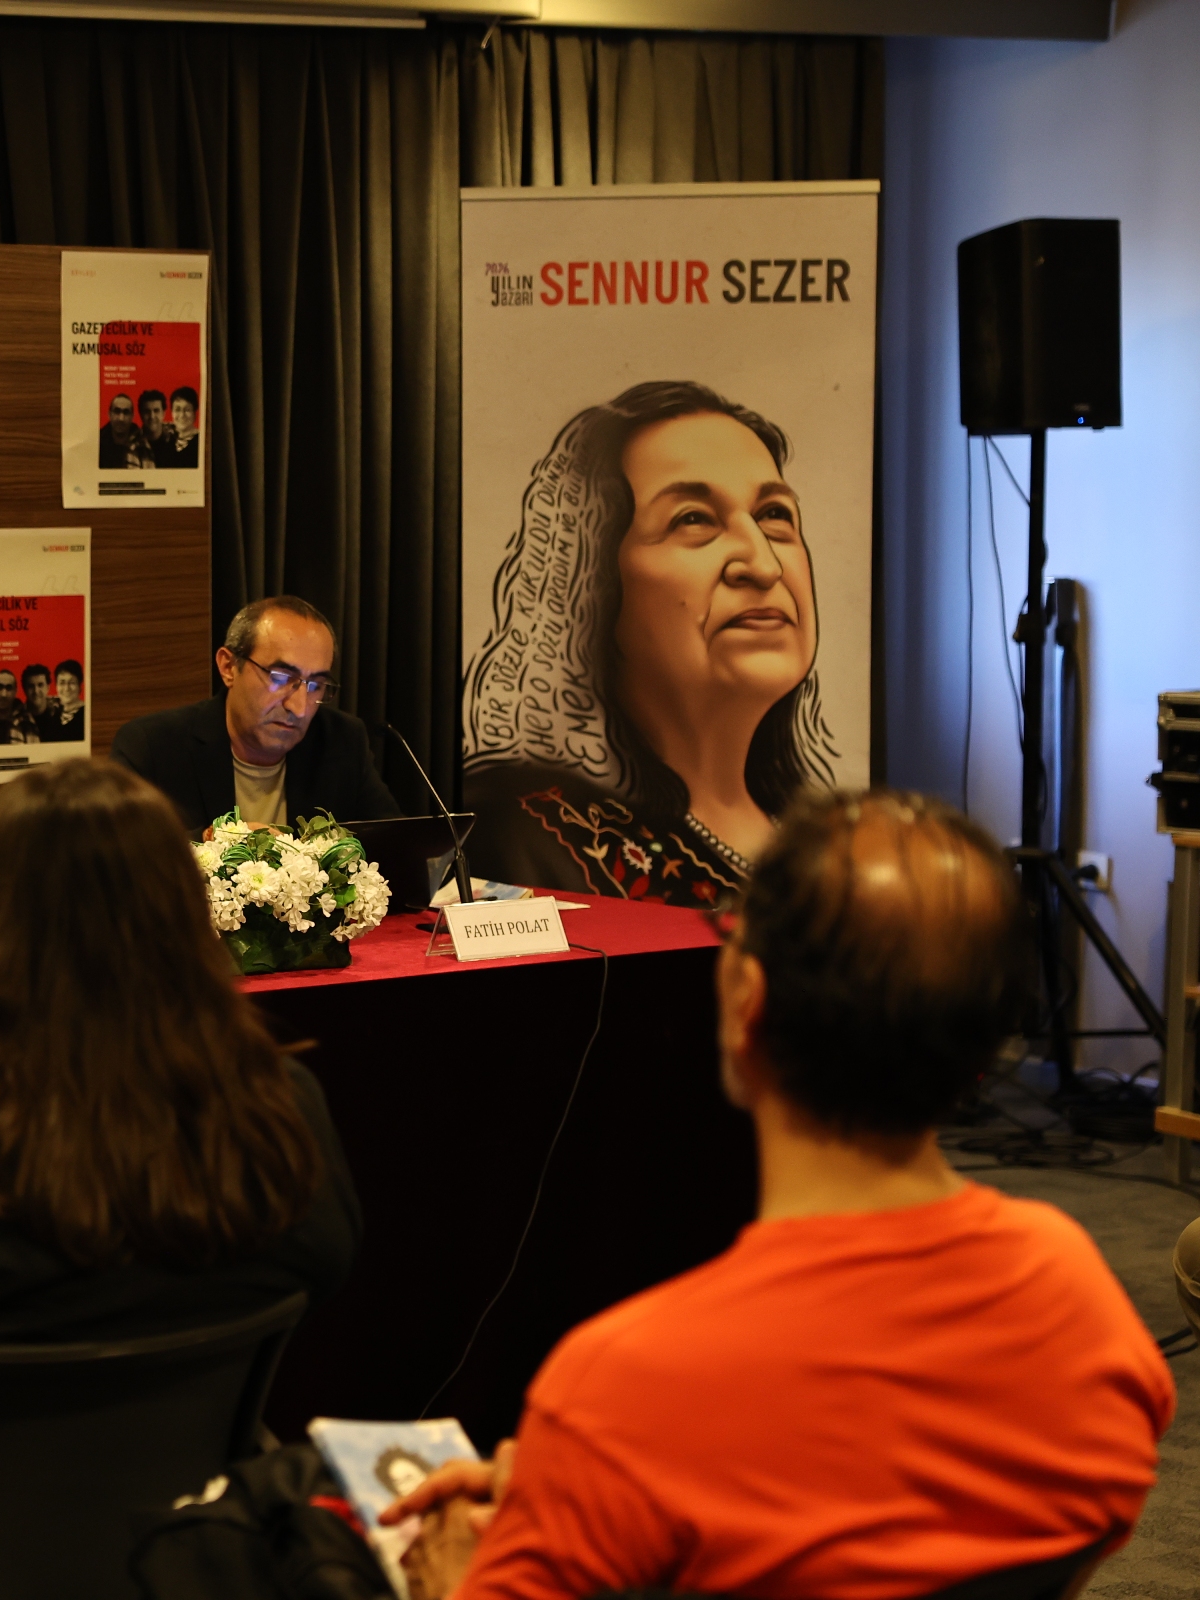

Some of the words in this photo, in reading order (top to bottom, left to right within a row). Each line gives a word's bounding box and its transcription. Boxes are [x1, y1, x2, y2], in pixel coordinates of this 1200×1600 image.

[540, 260, 710, 306] SENNUR
[722, 259, 851, 304] SEZER
[72, 320, 138, 335] GAZETECİLİK
[141, 323, 153, 335] VE
[72, 343, 123, 356] KAMUSAL
[126, 341, 145, 356] SÖZ
[25, 598, 37, 610] VE
[8, 616, 29, 631] SÖZ
[530, 677, 550, 693] O
[464, 920, 505, 938] FATİH
[507, 918, 550, 935] POLAT
